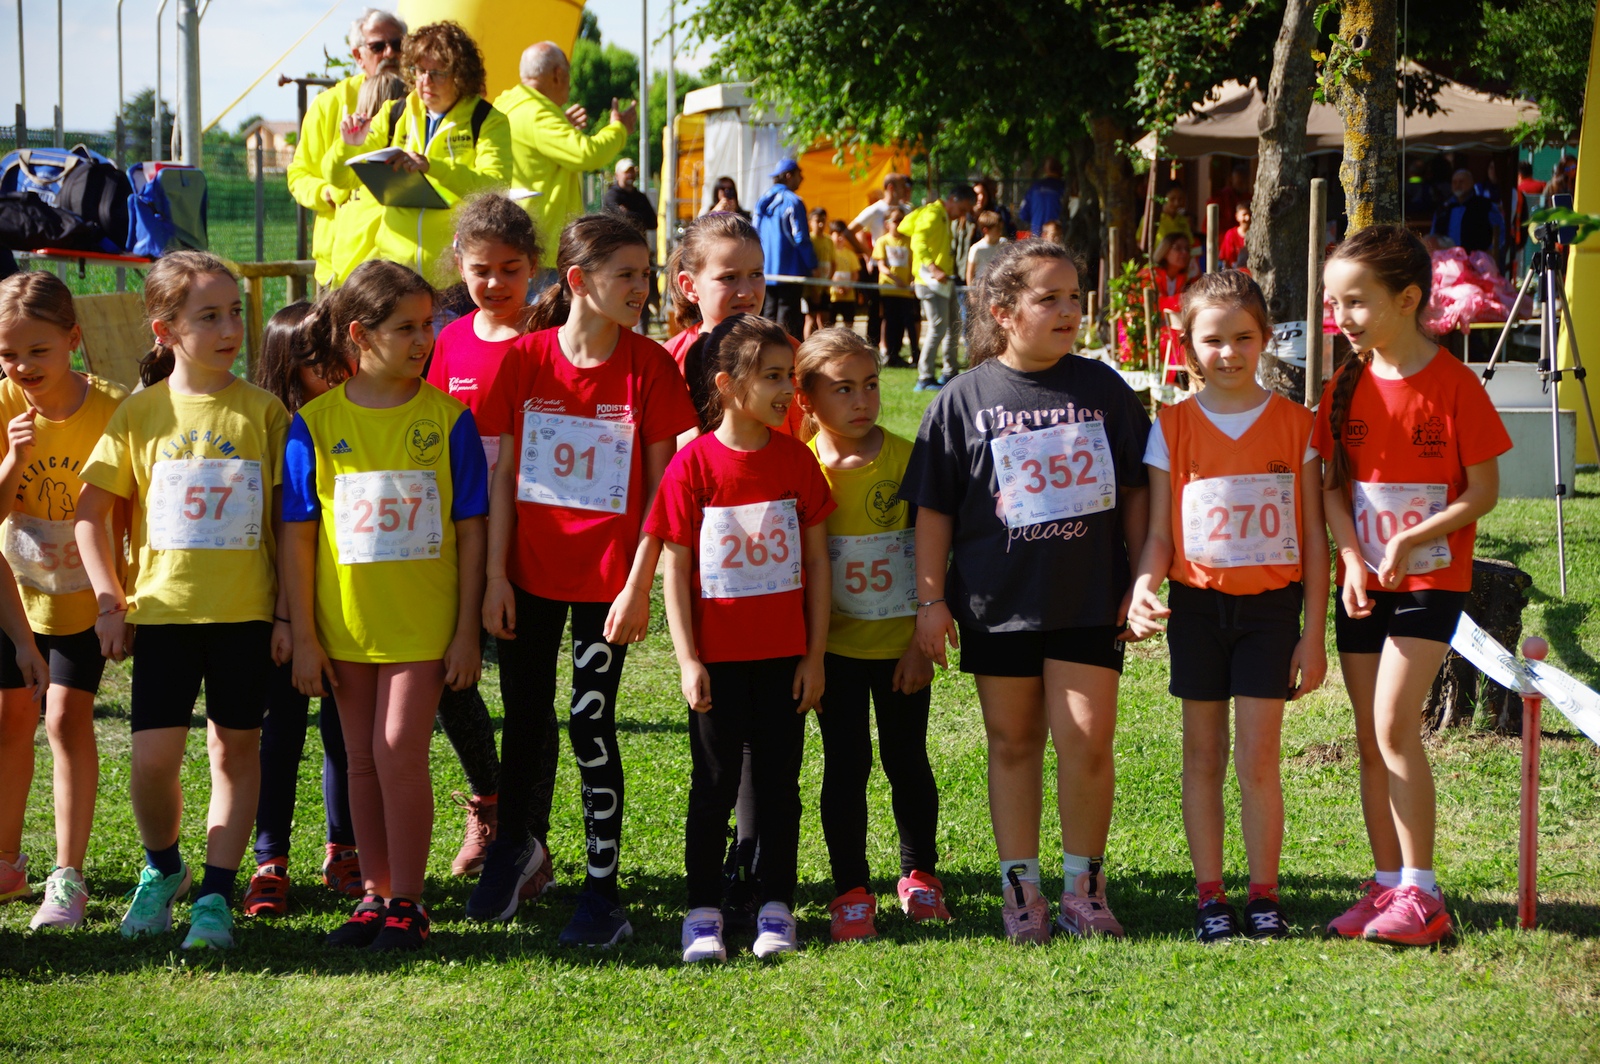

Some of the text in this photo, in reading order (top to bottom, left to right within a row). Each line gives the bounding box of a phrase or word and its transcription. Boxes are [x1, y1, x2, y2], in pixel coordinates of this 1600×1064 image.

[975, 402, 1105, 433] Cherries
[1347, 425, 1365, 435] UCC
[330, 447, 353, 455] adidas
[553, 443, 596, 481] 91
[1021, 450, 1097, 493] 352
[183, 486, 233, 521] 57
[352, 497, 423, 534] 257
[1006, 521, 1089, 553] please
[1206, 503, 1280, 542] 270
[38, 541, 82, 572] 58
[719, 528, 790, 570] 263
[845, 558, 893, 595] 55
